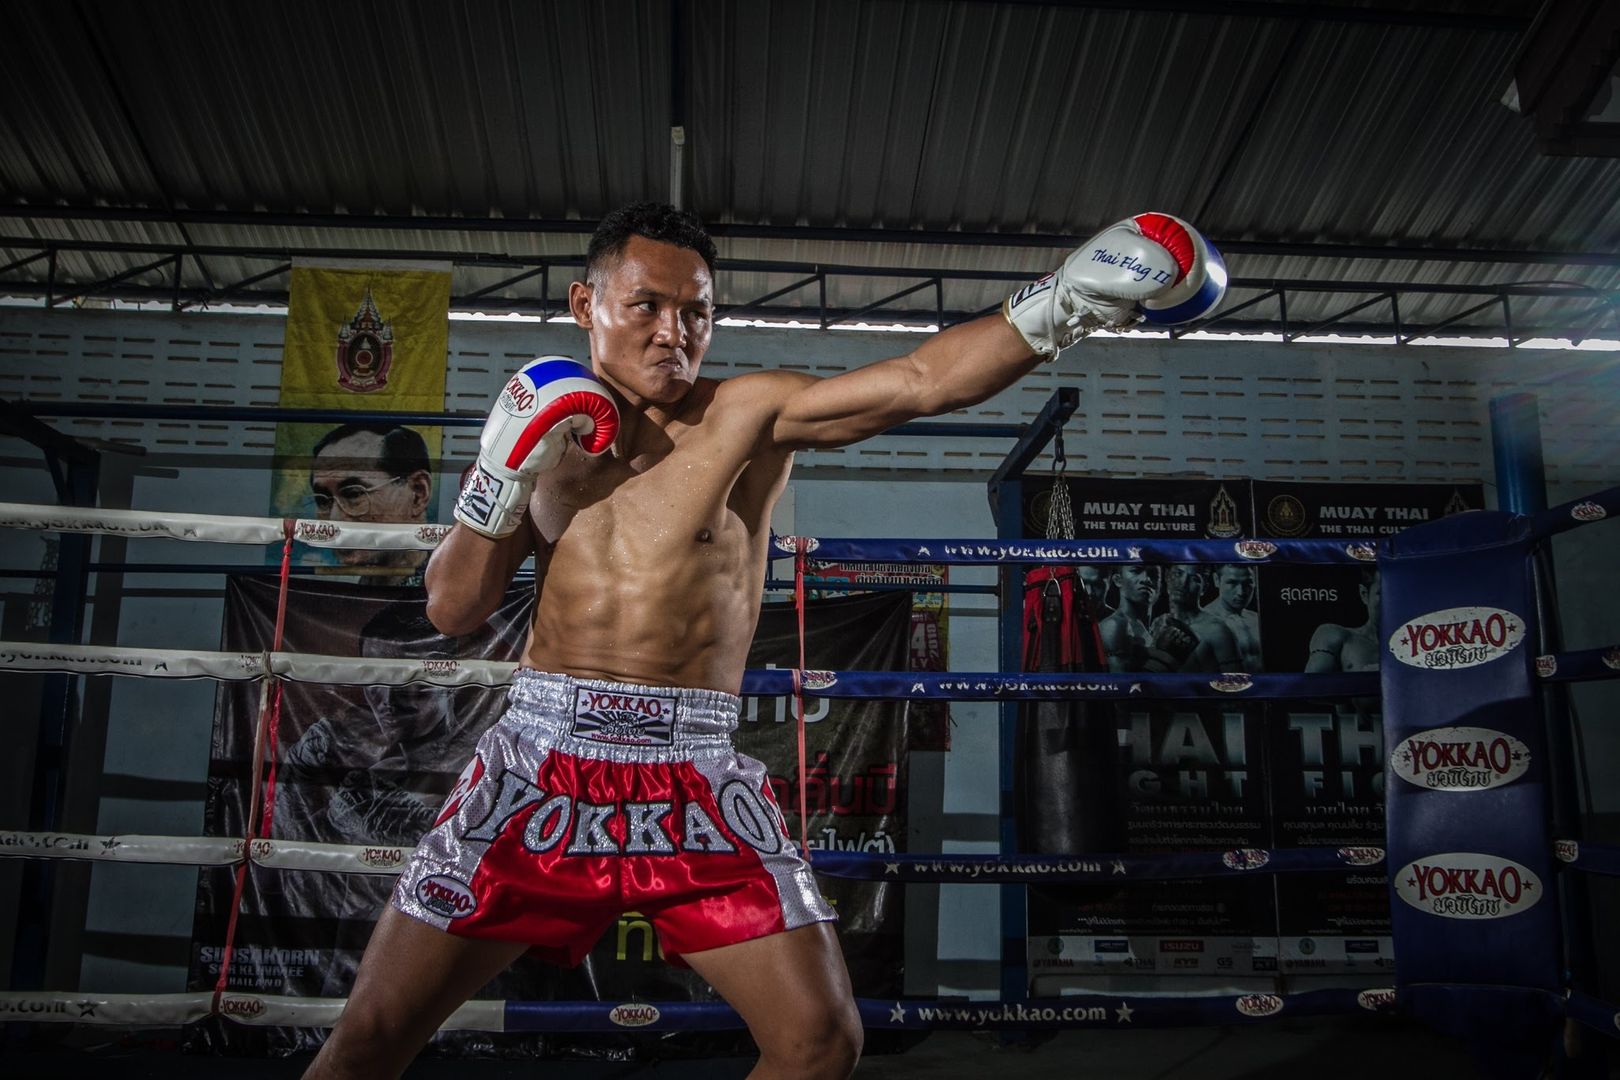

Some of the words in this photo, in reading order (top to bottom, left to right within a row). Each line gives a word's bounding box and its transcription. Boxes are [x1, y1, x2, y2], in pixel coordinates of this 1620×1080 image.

[1091, 249, 1121, 265] Thai
[1119, 256, 1152, 282] Flag
[1153, 269, 1172, 284] II
[1083, 502, 1143, 516] MUAY
[1150, 502, 1196, 517] THAI
[1320, 505, 1376, 520] MUAY
[1384, 507, 1429, 521] THAI
[1083, 521, 1107, 530] THE
[1111, 521, 1139, 530] THAI
[1143, 522, 1196, 532] CULTURE
[1320, 524, 1344, 534] THE
[1346, 525, 1375, 535] THAI
[1280, 586, 1339, 606] สุดสาคร
[1406, 613, 1507, 657] YOKKAO
[588, 692, 661, 717] YOKKAO
[1408, 737, 1511, 775] YOKKAO
[463, 769, 781, 856] YOKKAO
[365, 848, 401, 861] YOKKAO
[914, 860, 1101, 876] www.yokkao.com
[1412, 864, 1521, 905] YOKKAO
[424, 880, 470, 912] YOKKAO
[1163, 942, 1200, 951] ISUZU
[223, 1000, 260, 1014] YOKKAO
[616, 1008, 653, 1021] YOKKAO
[918, 1003, 1107, 1025] www.yokkao.com
